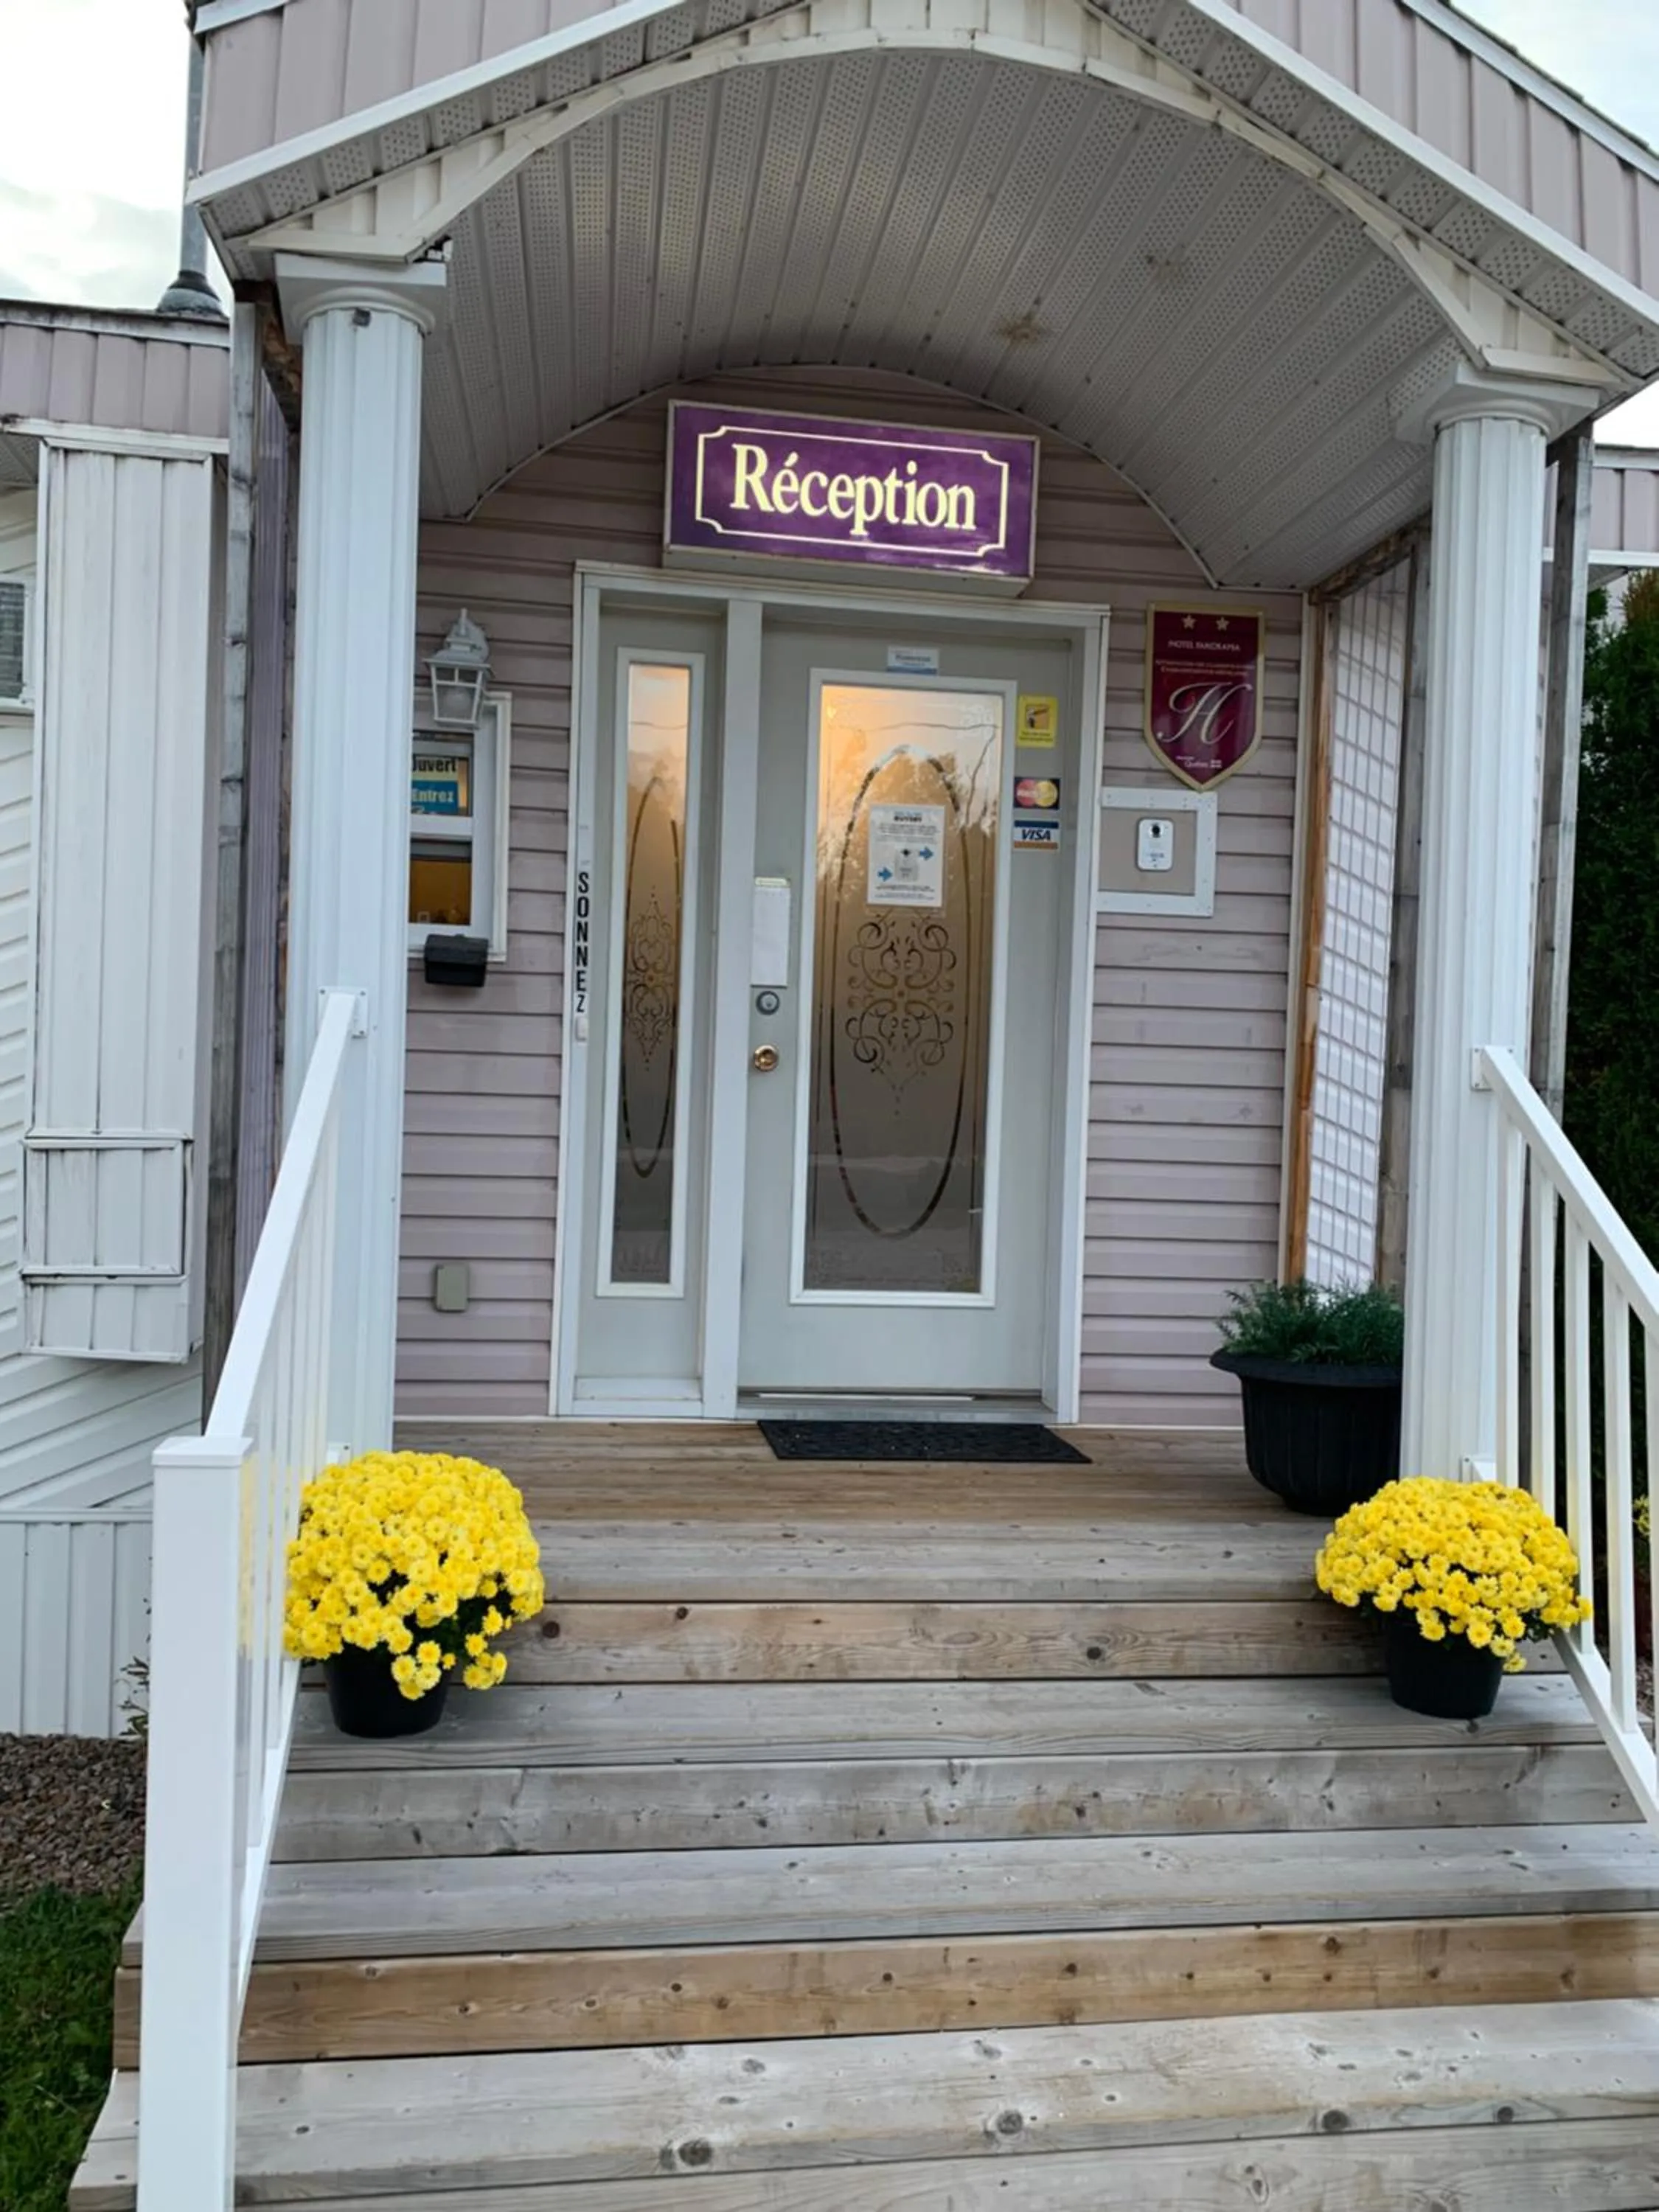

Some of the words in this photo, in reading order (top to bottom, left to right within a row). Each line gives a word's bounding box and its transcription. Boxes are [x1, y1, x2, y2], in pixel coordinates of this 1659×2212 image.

[729, 443, 976, 535] Réception
[1022, 829, 1051, 840] VISA
[576, 872, 590, 1013] SONNEZ
